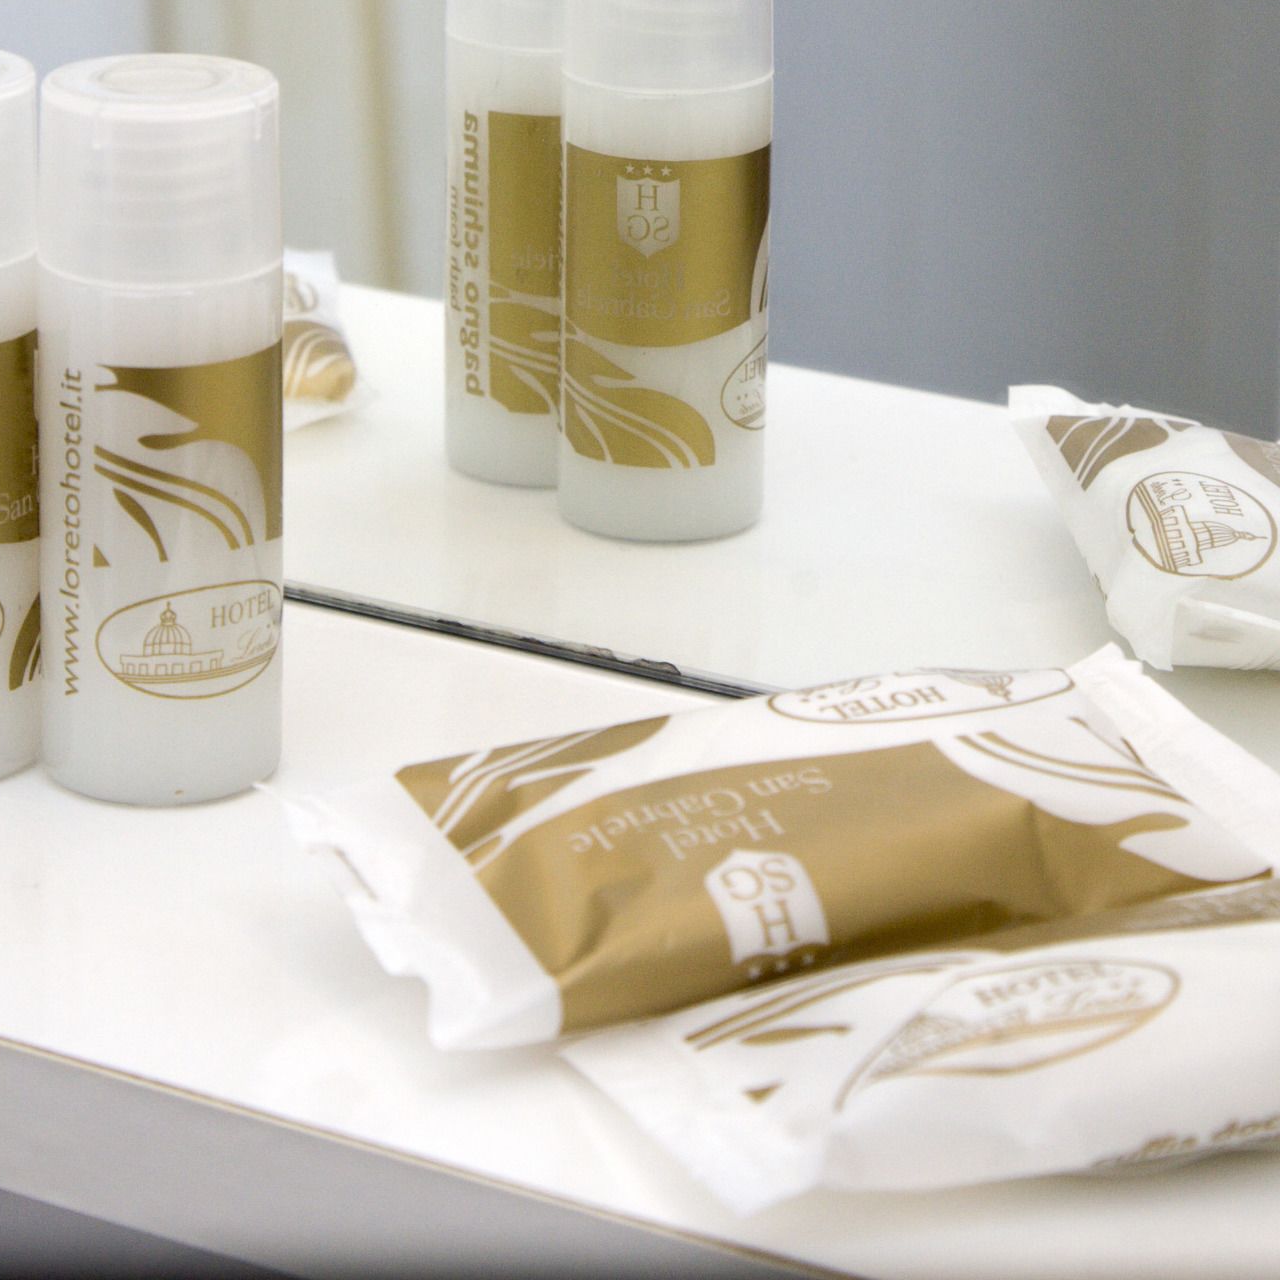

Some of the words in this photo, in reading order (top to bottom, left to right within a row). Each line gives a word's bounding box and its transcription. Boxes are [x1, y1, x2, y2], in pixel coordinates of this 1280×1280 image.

[59, 368, 83, 697] www.loretohotel.it
[211, 589, 274, 628] HOTEL
[818, 684, 951, 721] HOTEL
[748, 766, 834, 797] San
[570, 786, 747, 855] Gabriele
[659, 806, 788, 861] Hotel
